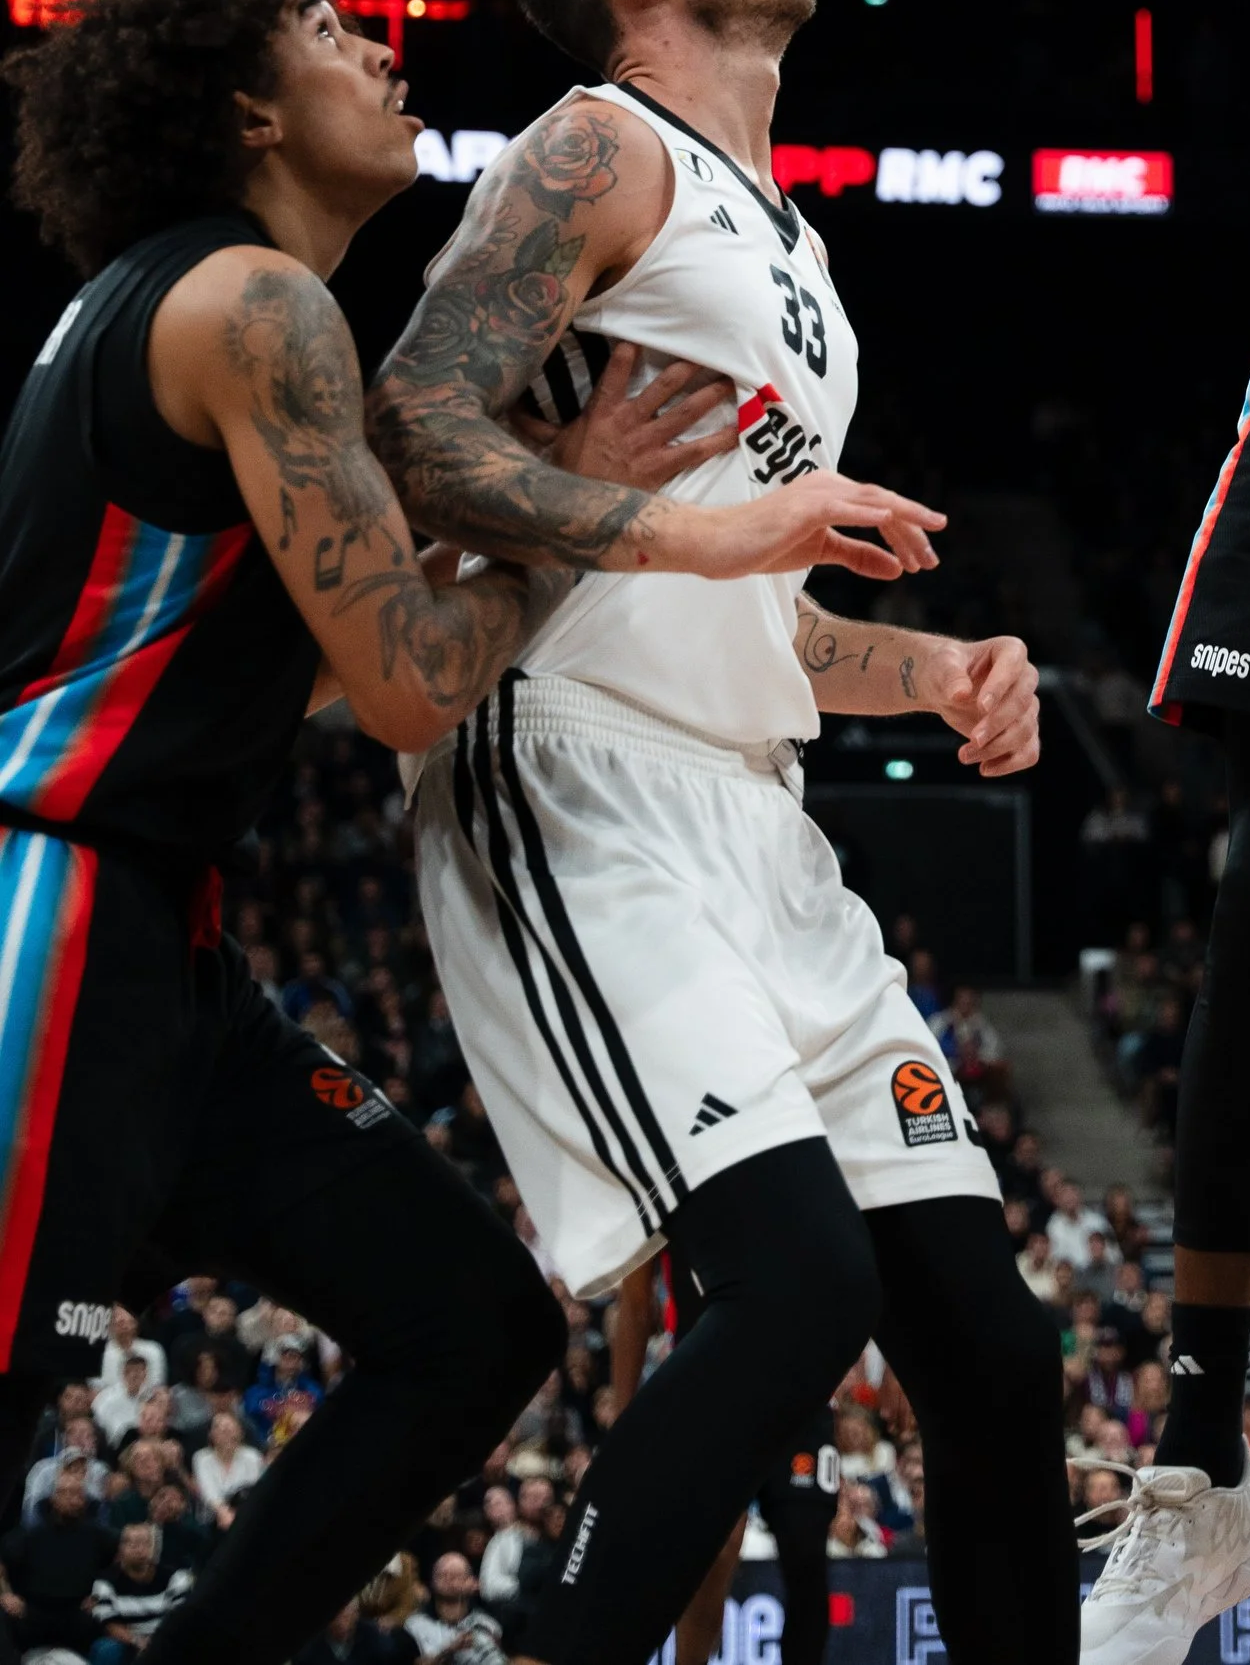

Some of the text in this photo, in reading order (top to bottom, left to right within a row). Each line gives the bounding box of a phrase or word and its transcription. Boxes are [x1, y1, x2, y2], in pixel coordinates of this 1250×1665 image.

[876, 147, 1004, 207] RMC
[769, 263, 828, 380] 33
[905, 1113, 950, 1127] TURKISH
[907, 1122, 952, 1136] AIRLINES
[561, 1501, 599, 1585] TECHFIT
